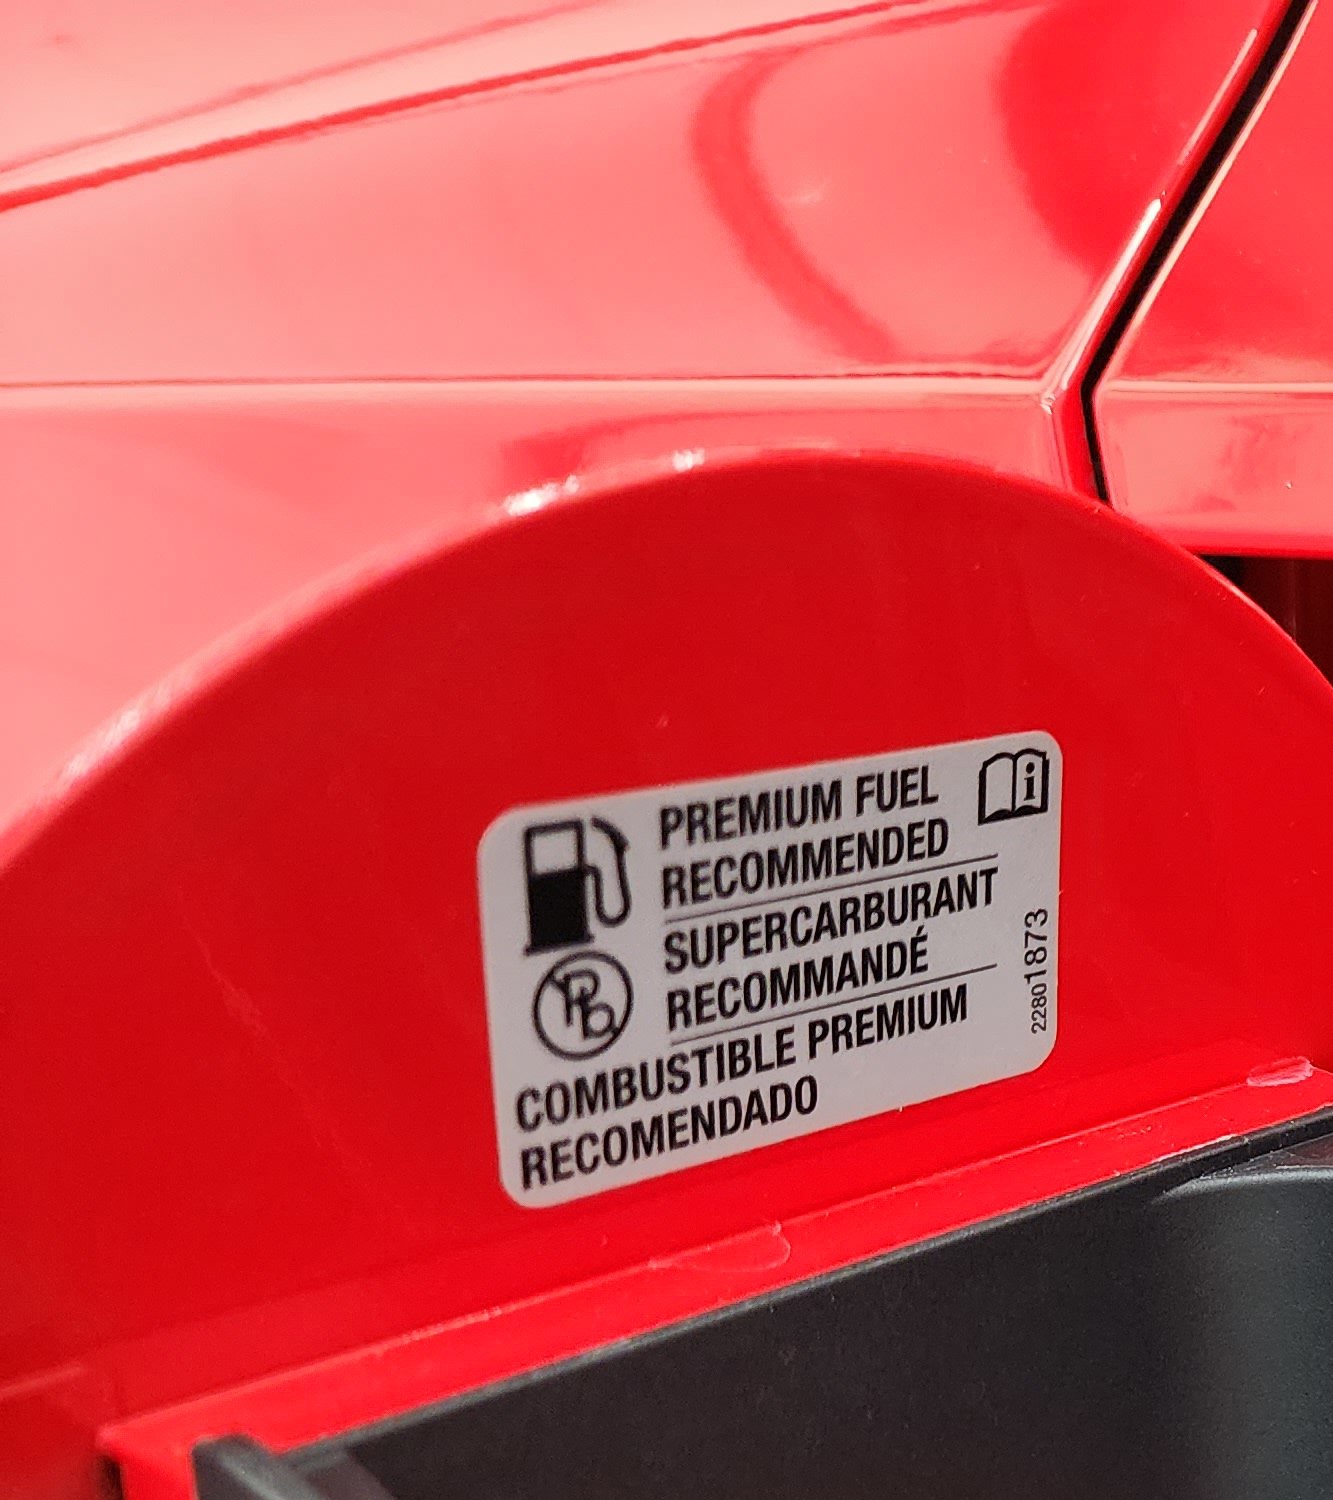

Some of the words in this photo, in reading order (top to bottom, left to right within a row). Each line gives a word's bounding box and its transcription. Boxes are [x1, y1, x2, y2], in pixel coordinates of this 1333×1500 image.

[660, 786, 842, 850] PREMIUM
[856, 765, 939, 814] FUEL
[662, 818, 949, 908] RECOMMENDED
[664, 867, 998, 975] SUPERCARBURANT
[1024, 907, 1049, 1035] 22801873
[667, 928, 929, 1032] RECOMMANDÉ
[516, 1037, 796, 1133] COMBUSTIBLE
[808, 983, 968, 1060] PREMIUM
[521, 1075, 819, 1191] RECOMENDADO
